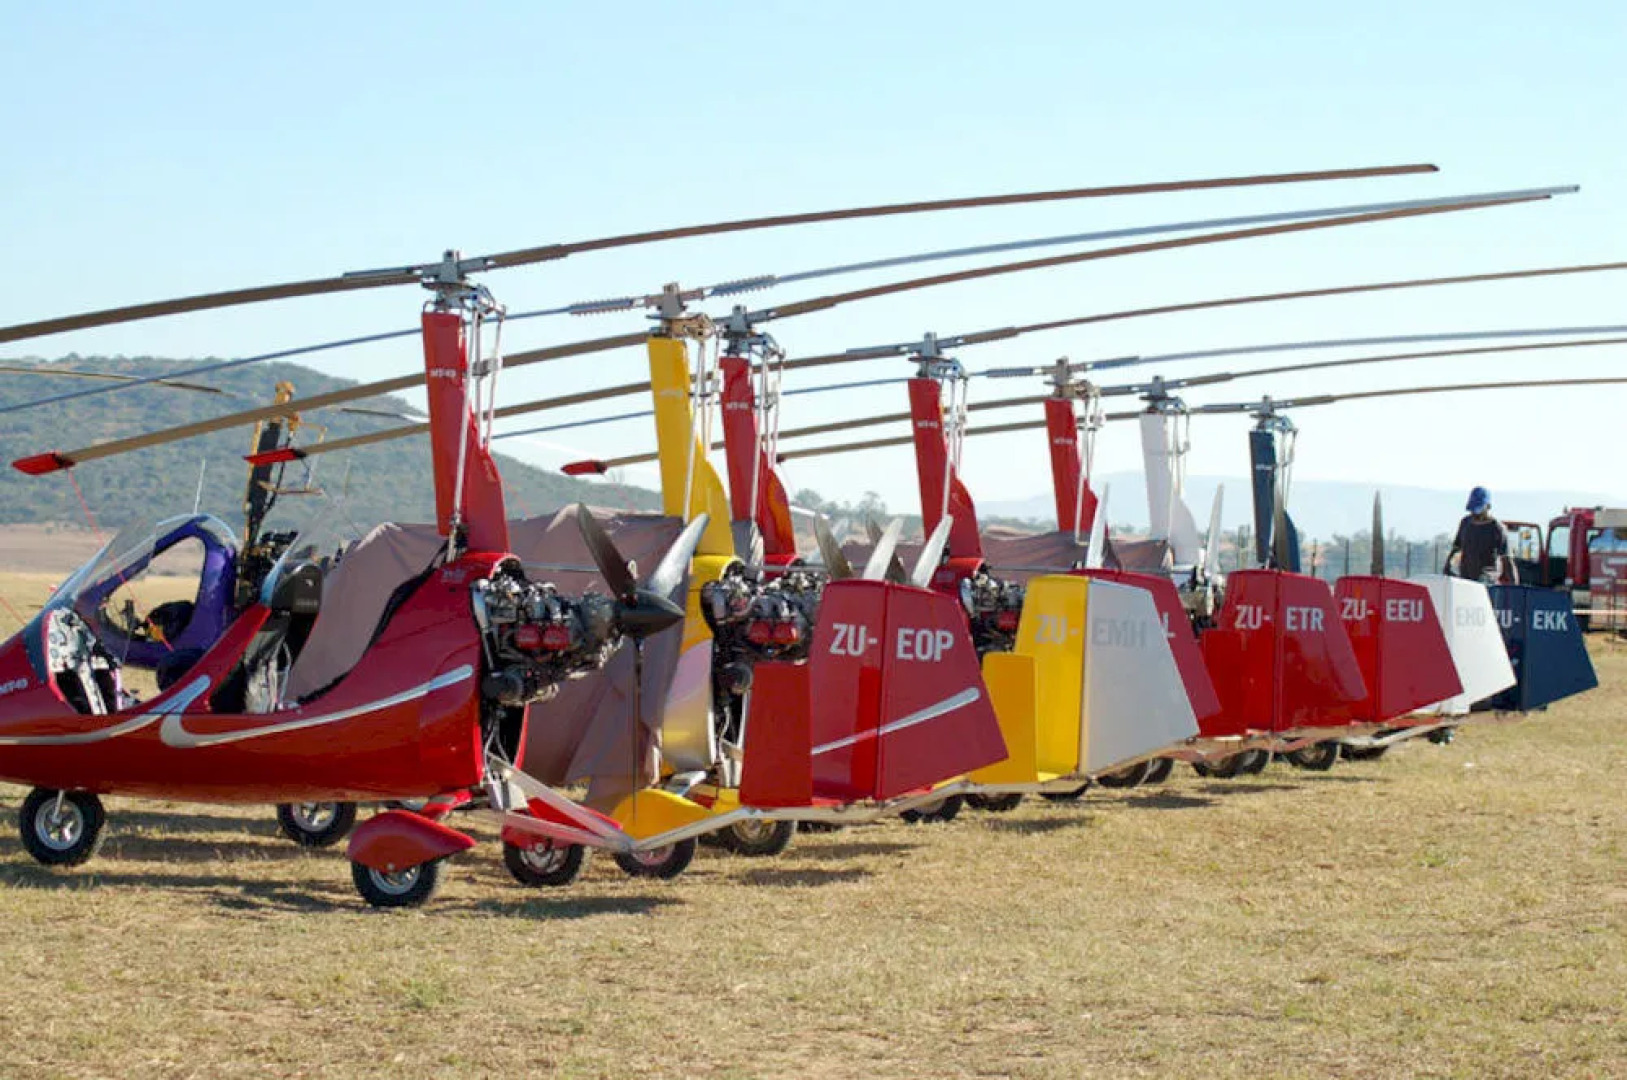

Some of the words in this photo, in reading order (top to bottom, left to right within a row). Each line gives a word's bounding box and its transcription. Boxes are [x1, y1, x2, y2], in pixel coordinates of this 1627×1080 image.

[1234, 604, 1273, 630] ZU-
[1285, 606, 1325, 632] ETR
[1340, 597, 1374, 621] ZU-
[1385, 598, 1424, 623] EEU
[1533, 609, 1569, 632] EKK
[829, 622, 878, 657] ZU-
[896, 628, 955, 662] EOP
[1034, 614, 1080, 645] ZU-
[1091, 617, 1147, 649] EMH
